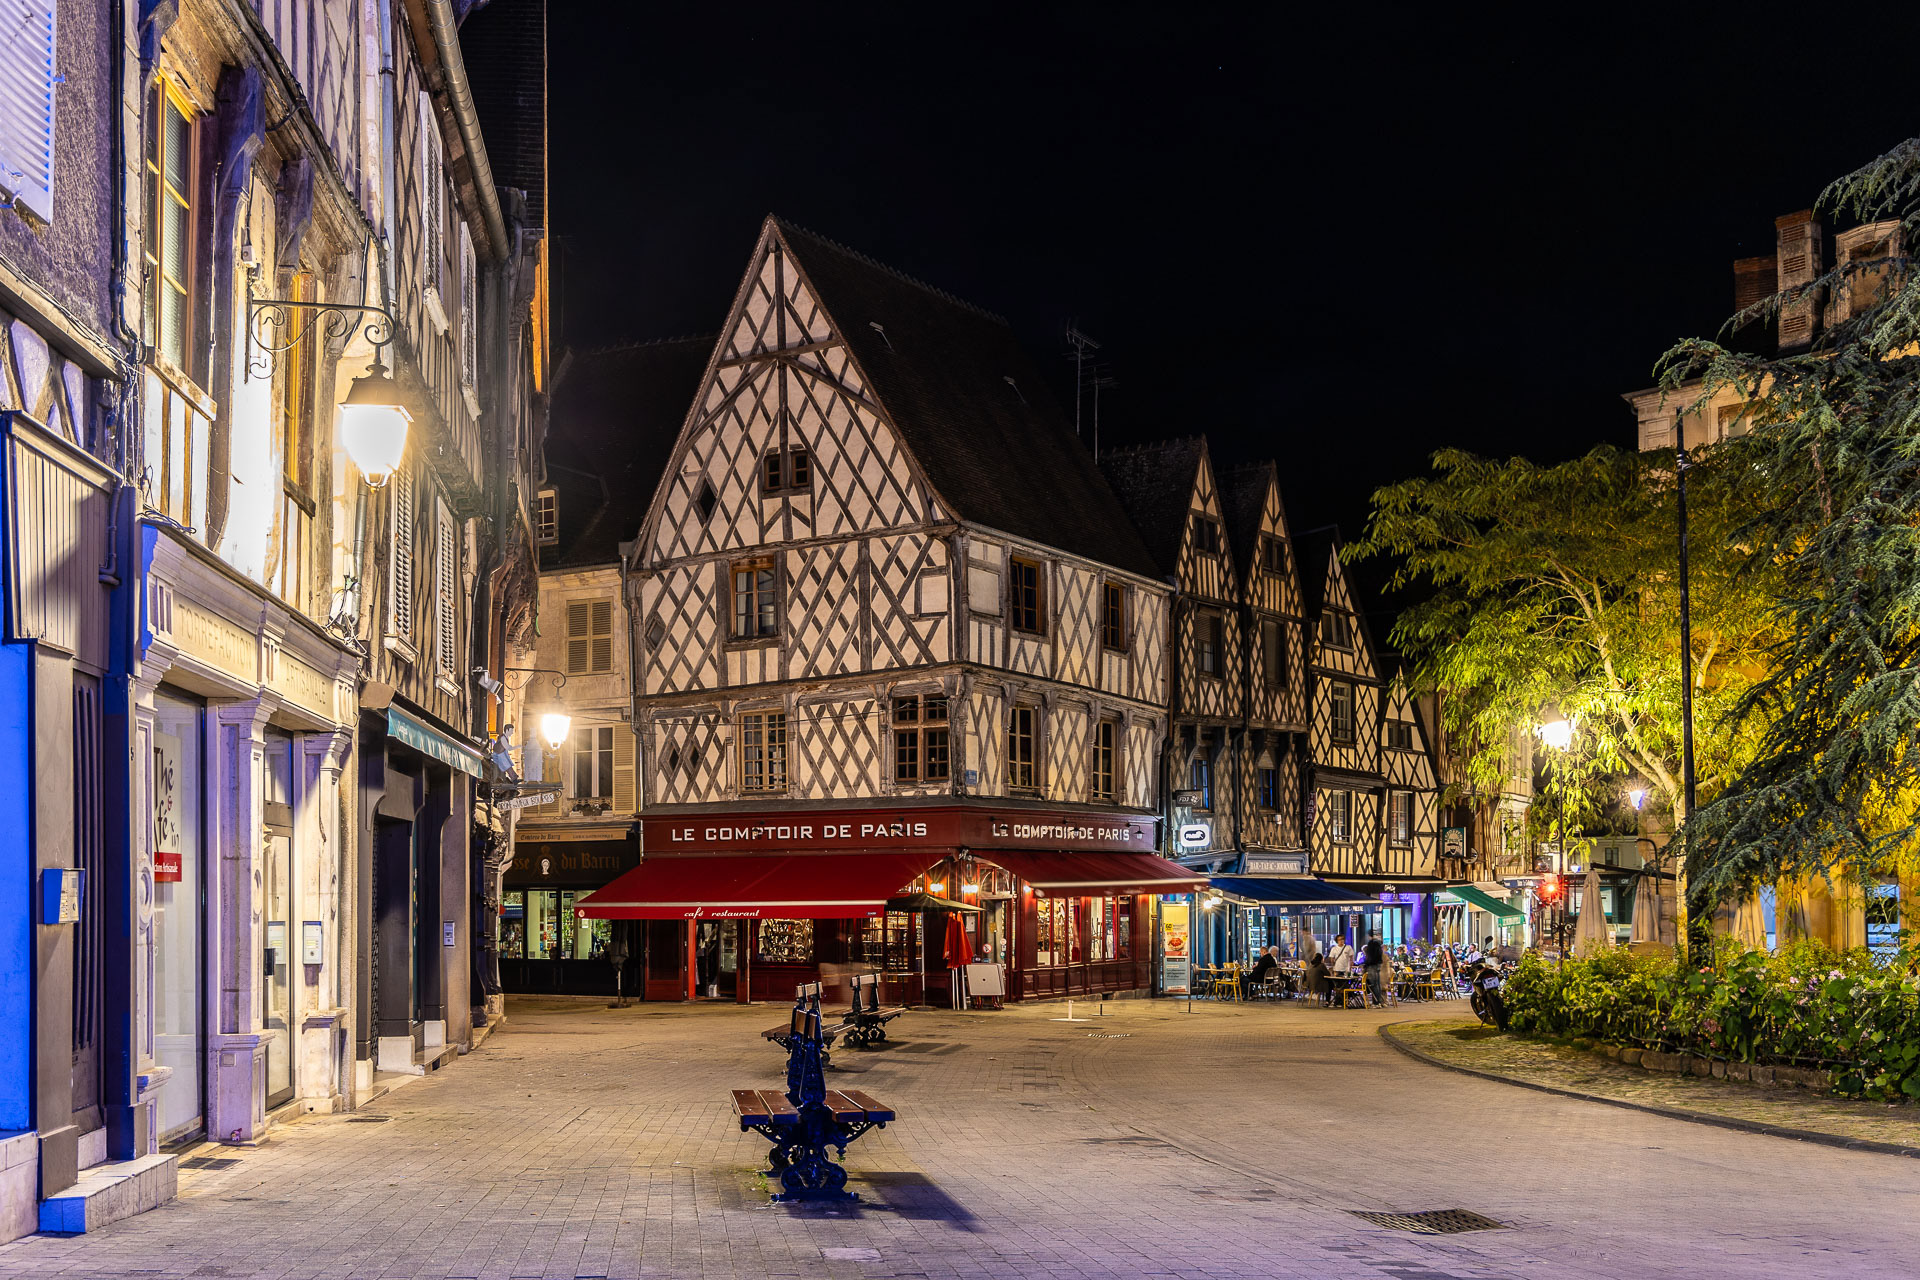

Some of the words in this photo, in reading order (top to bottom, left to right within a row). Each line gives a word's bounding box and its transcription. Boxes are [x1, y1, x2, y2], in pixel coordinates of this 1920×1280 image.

[178, 603, 252, 670] TORREFACTION
[286, 661, 326, 705] ARTISANALE
[1306, 792, 1316, 827] TABAC
[672, 828, 695, 842] LE
[705, 825, 813, 841] COMPTOIR
[823, 824, 852, 838] DE
[861, 822, 928, 838] PARIS
[992, 823, 1009, 837] LE
[1013, 824, 1075, 840] COMPTOIR
[1078, 827, 1094, 840] DE
[1097, 828, 1130, 841] PARIS
[561, 852, 577, 870] du
[581, 851, 620, 872] Barry
[683, 906, 704, 919] café
[711, 909, 760, 918] restaurant
